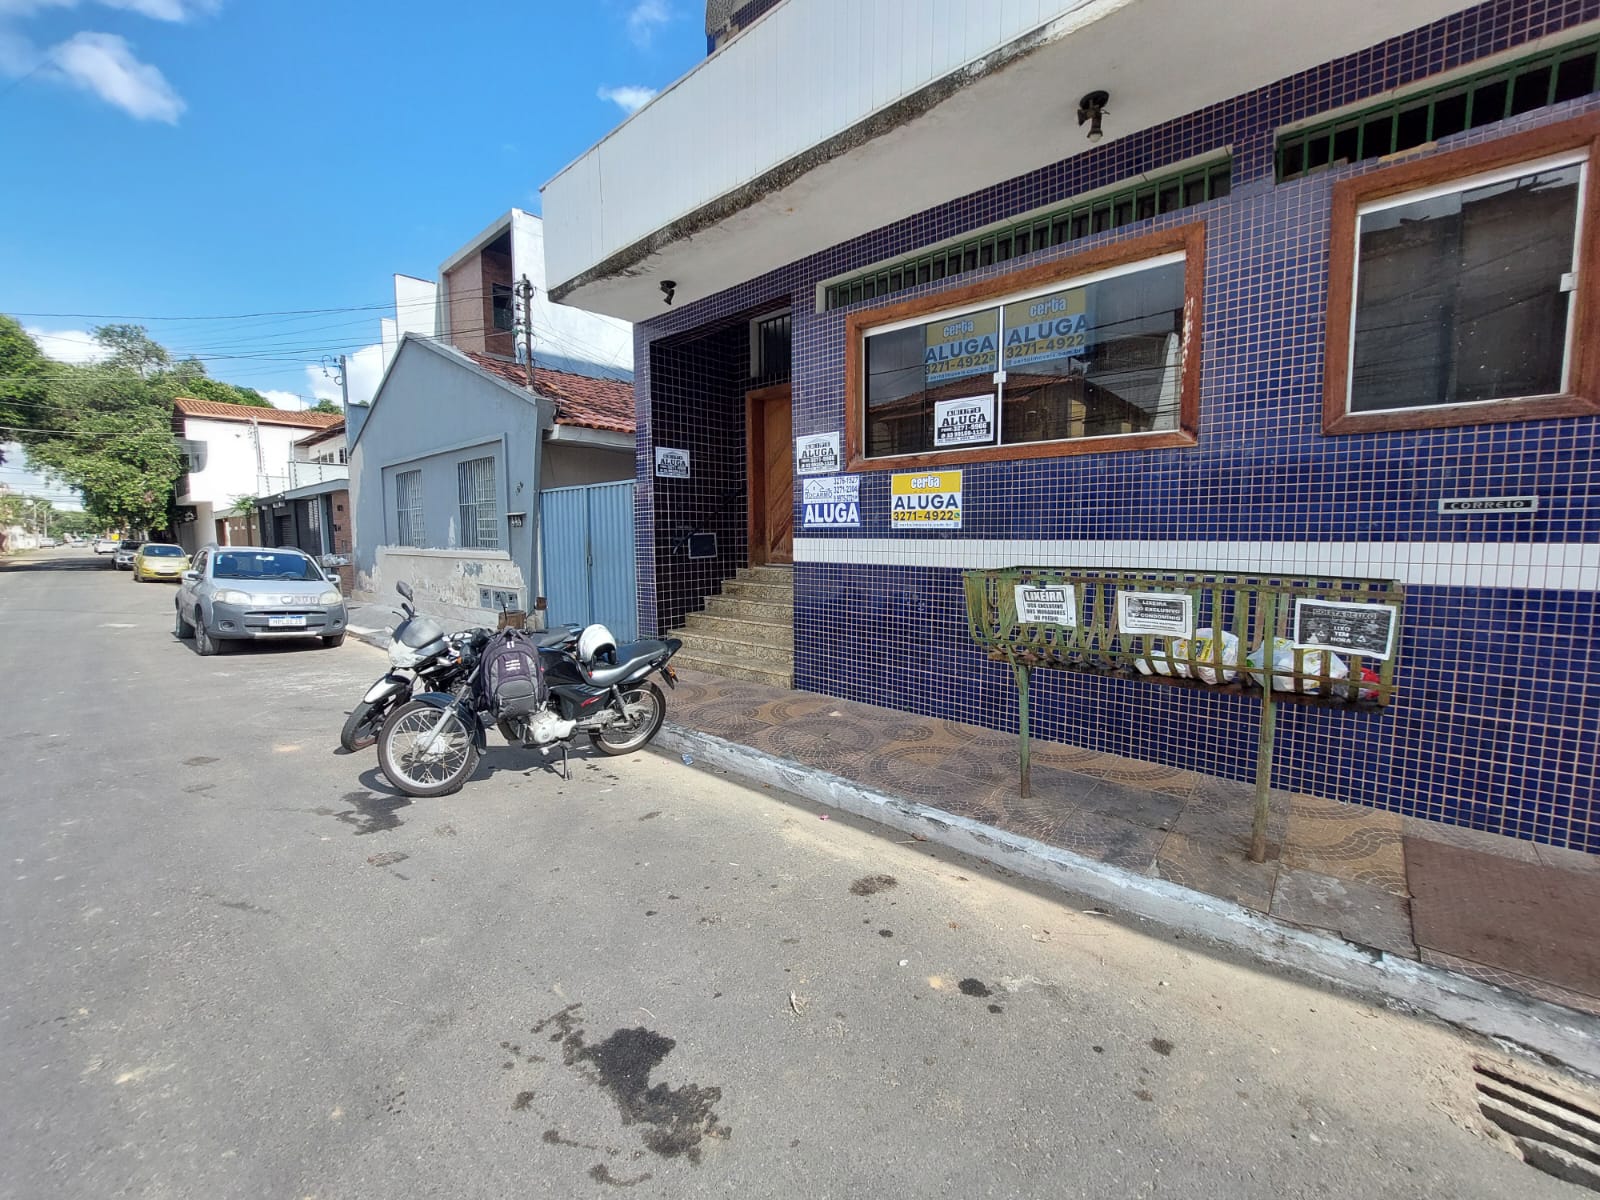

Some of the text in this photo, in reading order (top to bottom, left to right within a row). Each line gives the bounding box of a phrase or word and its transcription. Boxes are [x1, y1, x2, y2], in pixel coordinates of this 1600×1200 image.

[1030, 298, 1067, 317] certa
[944, 321, 974, 338] certa
[1007, 314, 1087, 346] ALUGA
[925, 336, 994, 363] ALUGA
[1006, 334, 1085, 359] 3271-4922
[925, 353, 989, 375] 3271-4922
[942, 413, 987, 427] ALUGA
[802, 448, 834, 458] ALUGA
[660, 459, 686, 468] ALUGA
[911, 475, 940, 489] certa
[894, 494, 959, 510] ALUGA
[1450, 501, 1524, 510] CORREIO
[804, 503, 859, 523] ALUGA
[893, 511, 954, 521] 3271-4922
[1024, 591, 1064, 602] LIXEIRA
